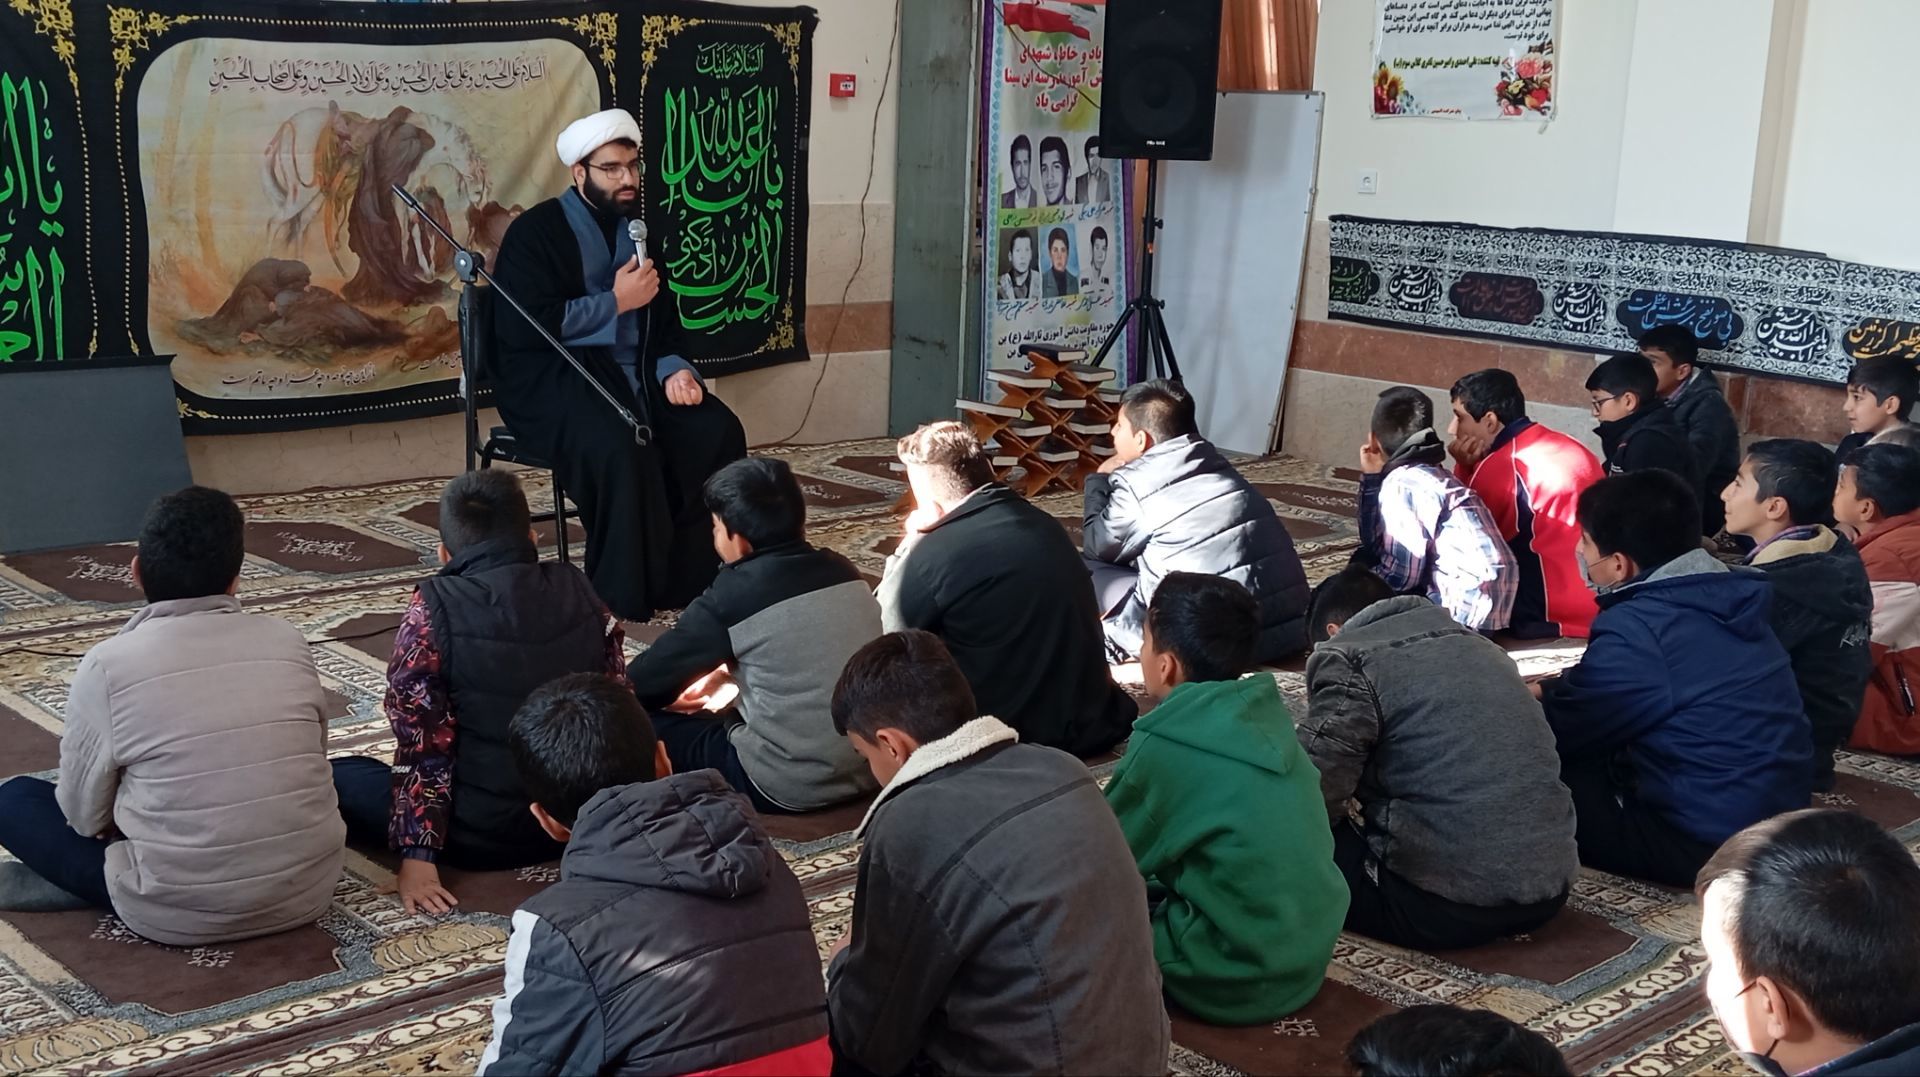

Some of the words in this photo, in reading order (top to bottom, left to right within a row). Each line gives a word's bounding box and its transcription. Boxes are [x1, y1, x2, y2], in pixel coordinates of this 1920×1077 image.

[1409, 3, 1417, 11] در
[1419, 1, 1427, 9] که
[1427, 1, 1439, 9] است
[1407, 12, 1417, 22] این
[1416, 12, 1430, 22] کسی
[1459, 13, 1468, 21] می
[1479, 9, 1498, 20] دیگران
[1498, 9, 1511, 19] برای
[1412, 23, 1425, 33] برای
[1426, 22, 1439, 32] آنچه
[1523, 31, 1536, 41] خود
[1536, 31, 1549, 41] برای
[1080, 51, 1087, 65] و
[1004, 67, 1021, 87] سینا
[1035, 91, 1048, 112] باد
[1050, 92, 1079, 112] گرامی
